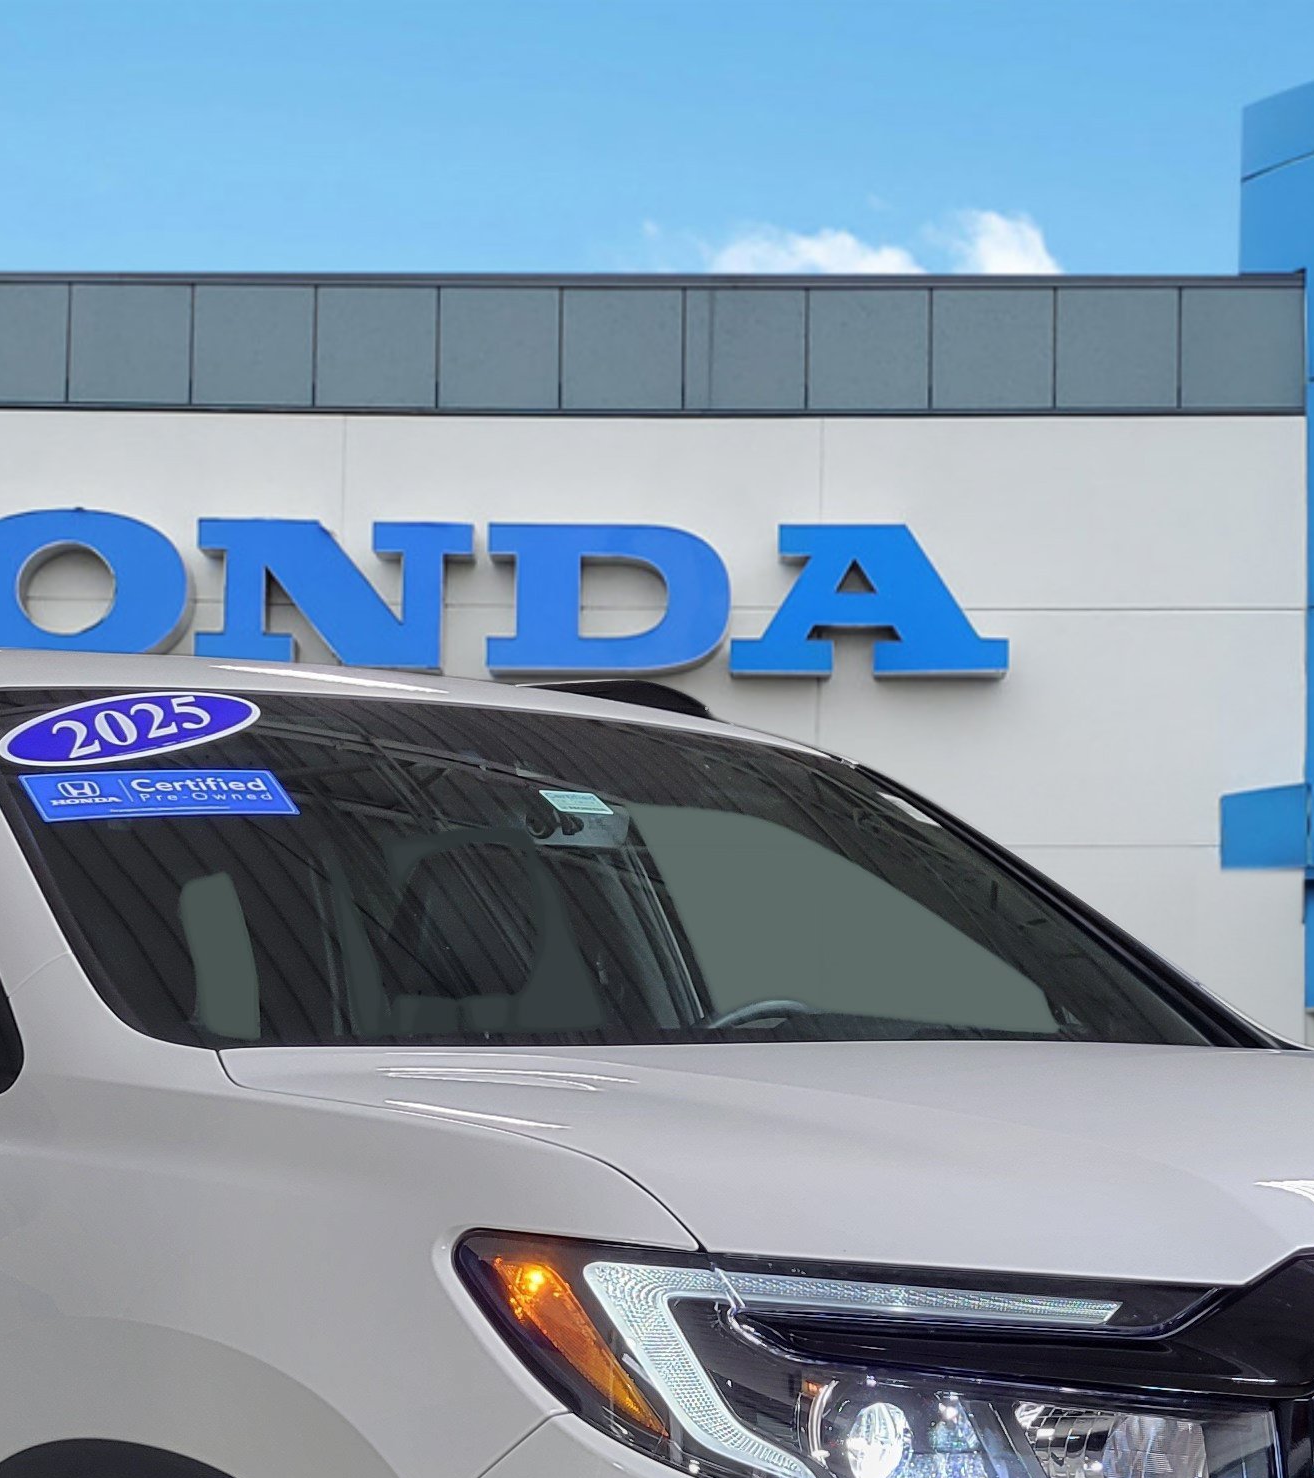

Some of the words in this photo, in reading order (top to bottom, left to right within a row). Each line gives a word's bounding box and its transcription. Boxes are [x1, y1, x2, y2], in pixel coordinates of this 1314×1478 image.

[51, 695, 212, 759] 2025
[131, 777, 268, 794] Certified
[49, 796, 123, 806] HONDA
[139, 790, 274, 803] Pre-Owned
